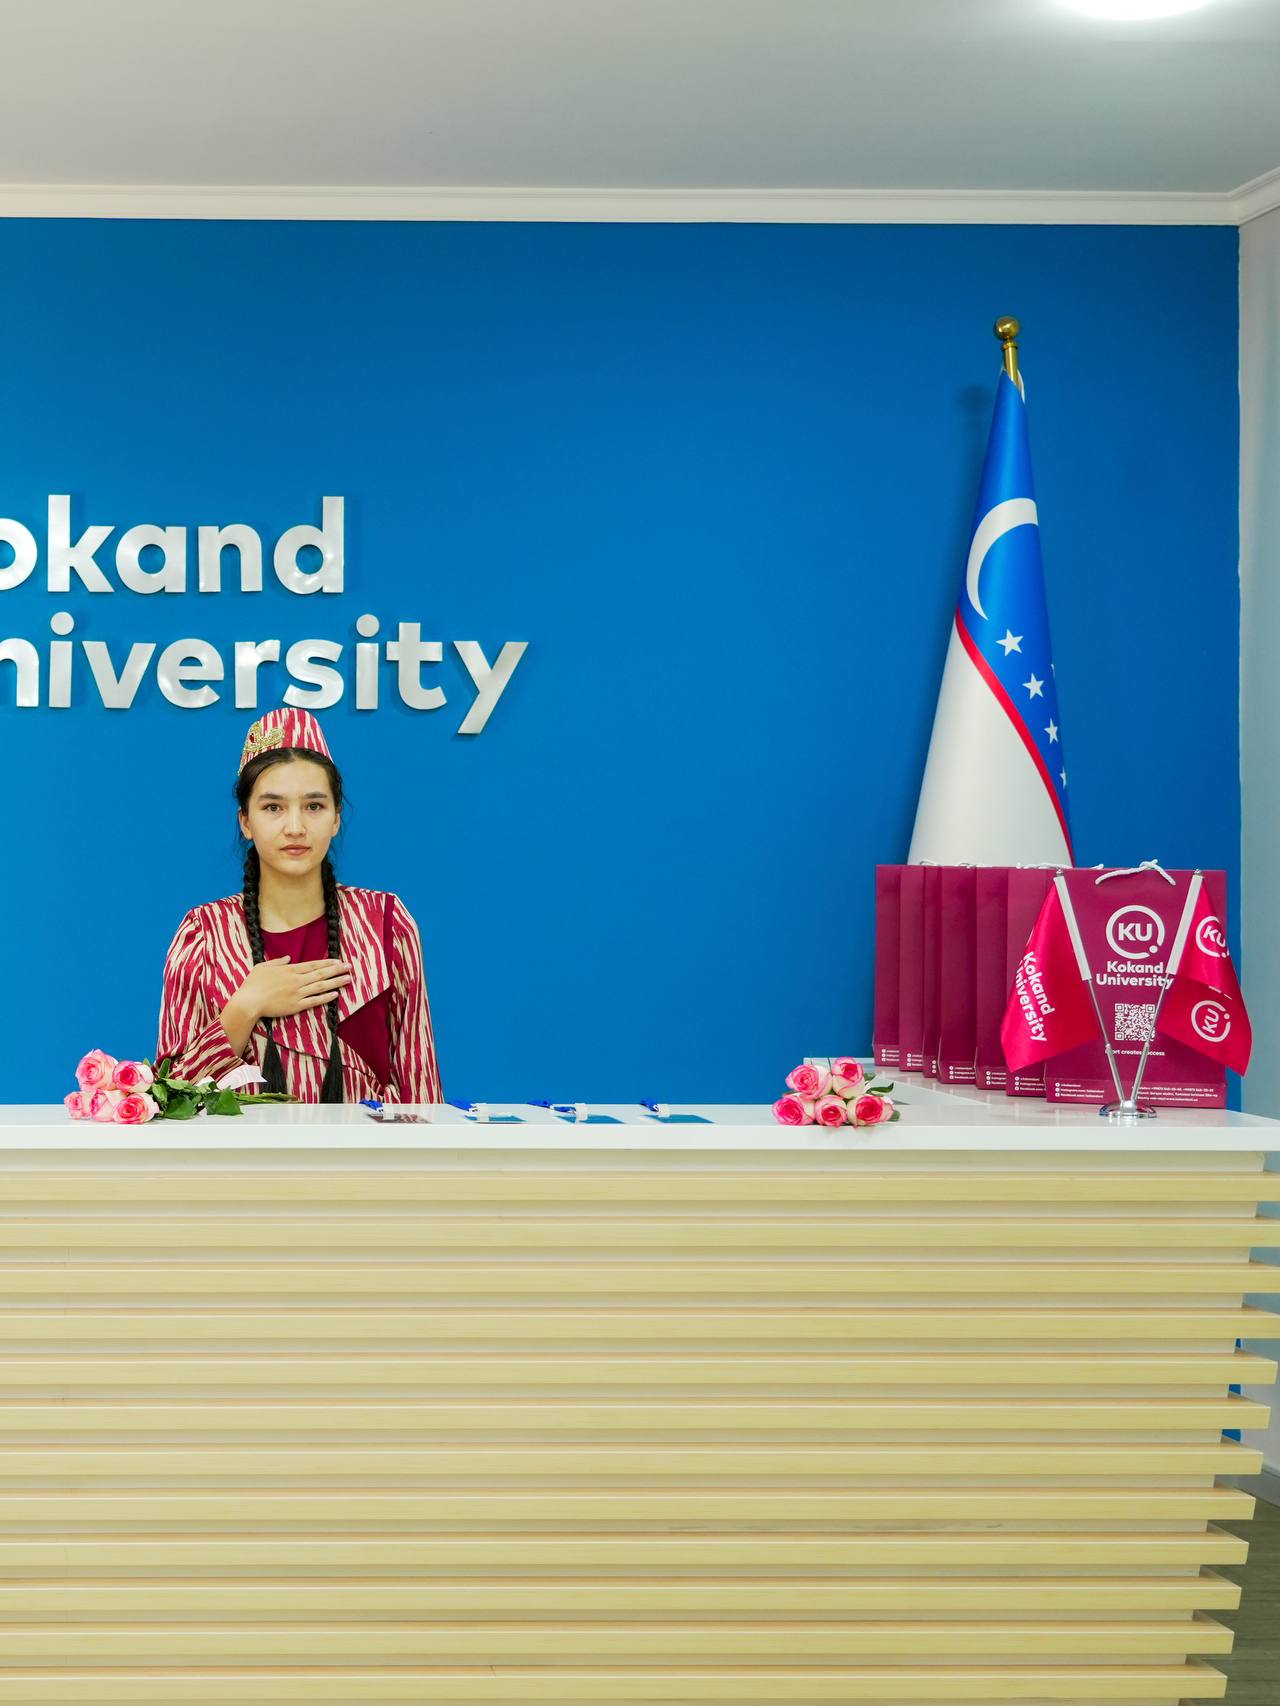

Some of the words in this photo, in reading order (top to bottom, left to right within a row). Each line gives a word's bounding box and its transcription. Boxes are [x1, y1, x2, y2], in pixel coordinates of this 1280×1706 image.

[1118, 923, 1153, 941] KU
[1203, 925, 1226, 948] KU
[1107, 961, 1164, 974] Kokand
[1023, 951, 1056, 1016] Kokand
[1096, 973, 1175, 990] University
[1201, 1008, 1220, 1035] KU
